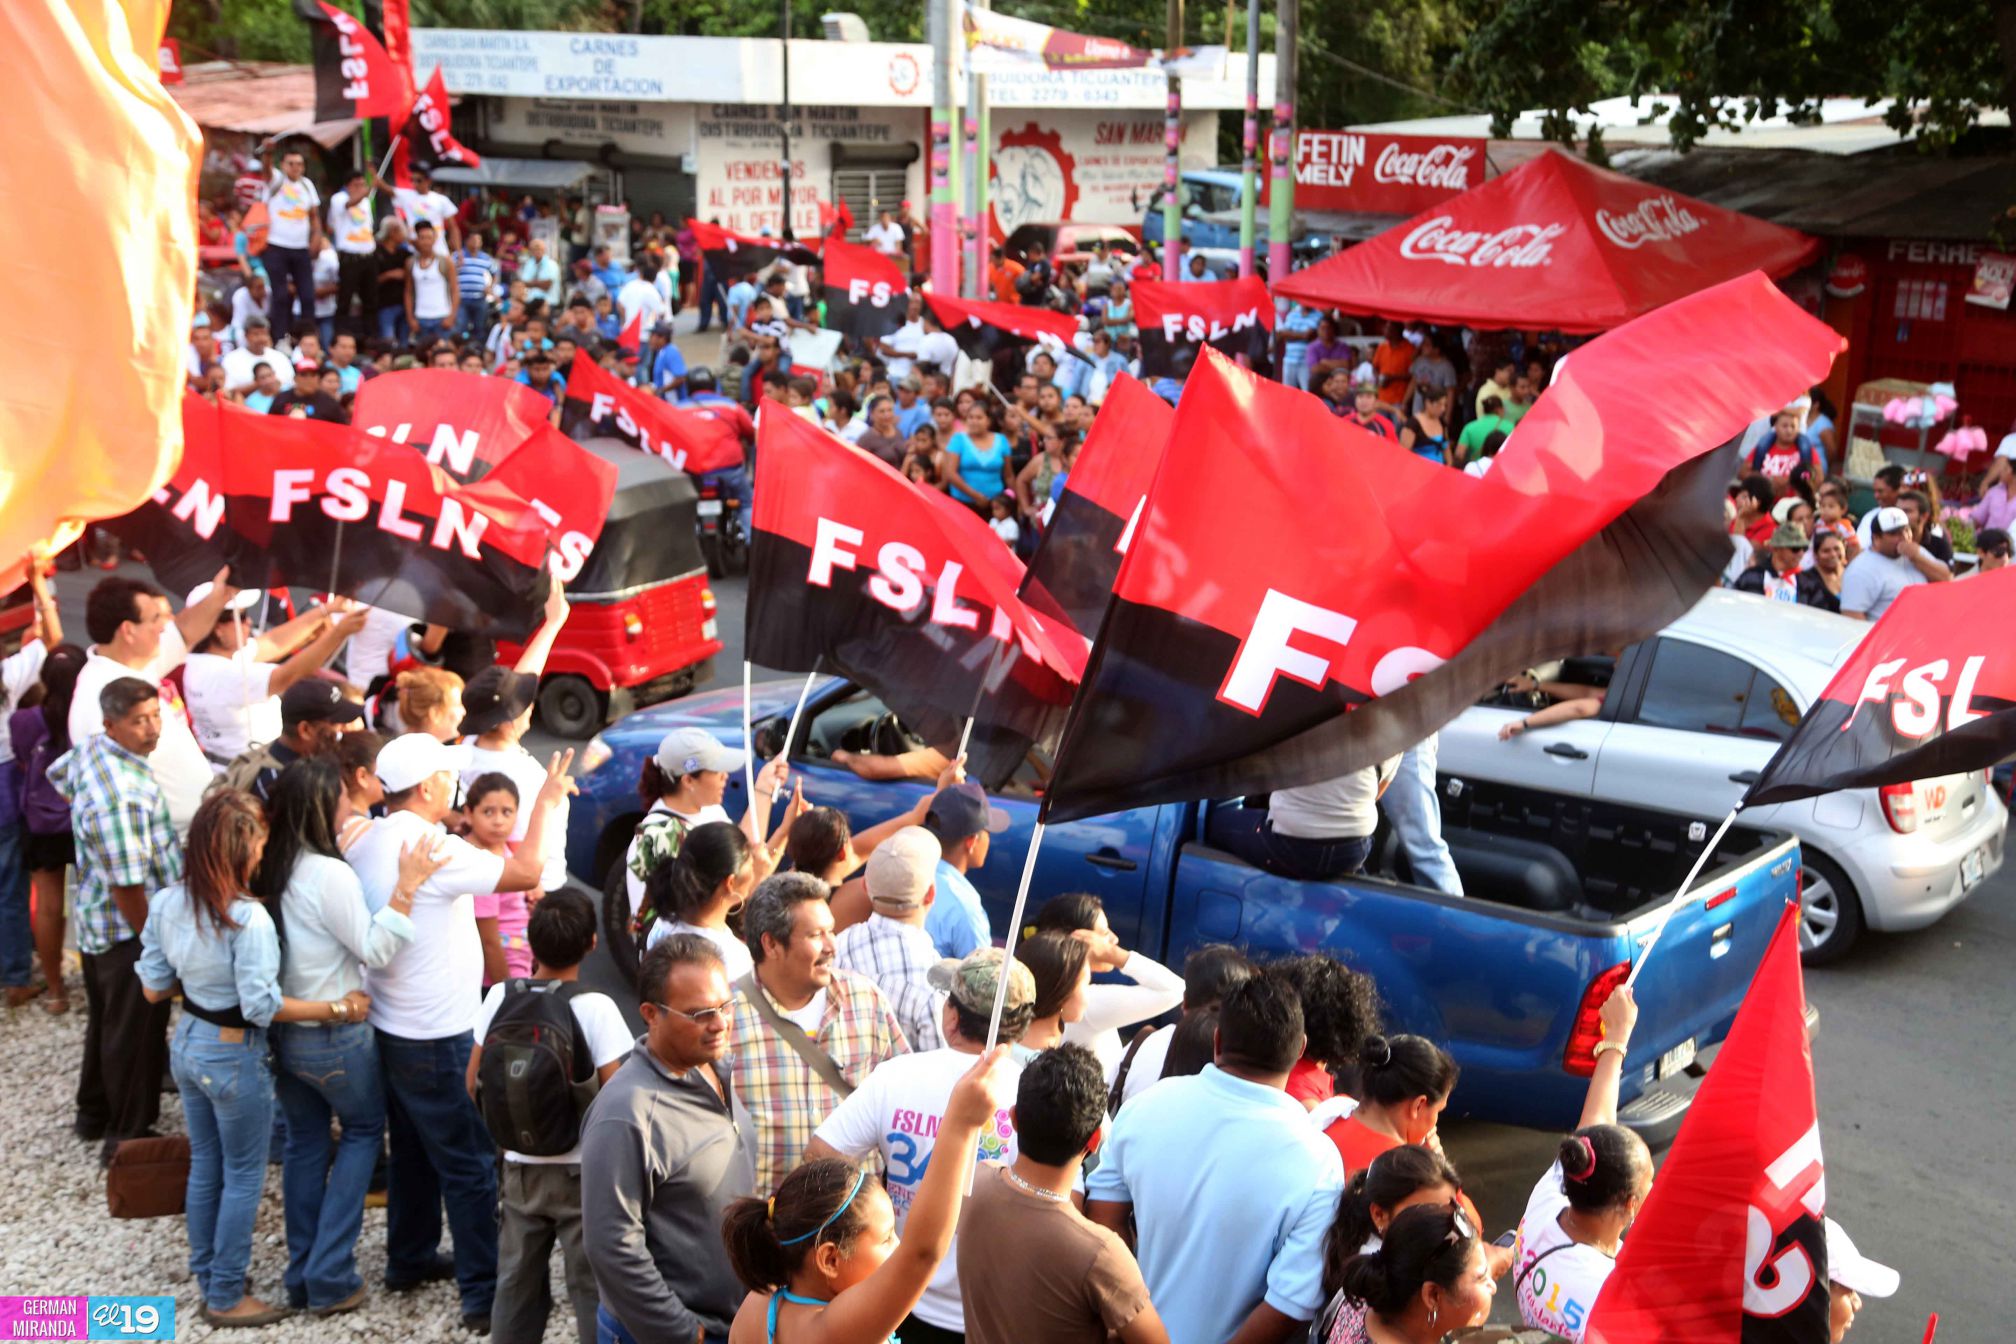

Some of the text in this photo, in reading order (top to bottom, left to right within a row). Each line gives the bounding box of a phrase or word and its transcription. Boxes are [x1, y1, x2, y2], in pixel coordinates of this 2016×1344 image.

[571, 38, 638, 57] CARNES
[592, 58, 616, 75] DE
[545, 75, 663, 95] EXPORTACION
[1374, 143, 1477, 191] Coca-Cola
[708, 186, 820, 207] AL POR MYOR
[1400, 215, 1568, 268] Coca-Cola
[1595, 195, 1706, 249] Coca-Cola
[1161, 306, 1258, 344] FSLN
[590, 391, 689, 473] FSLN
[268, 466, 490, 561] FSLN
[1522, 1248, 1586, 1331] 2015
